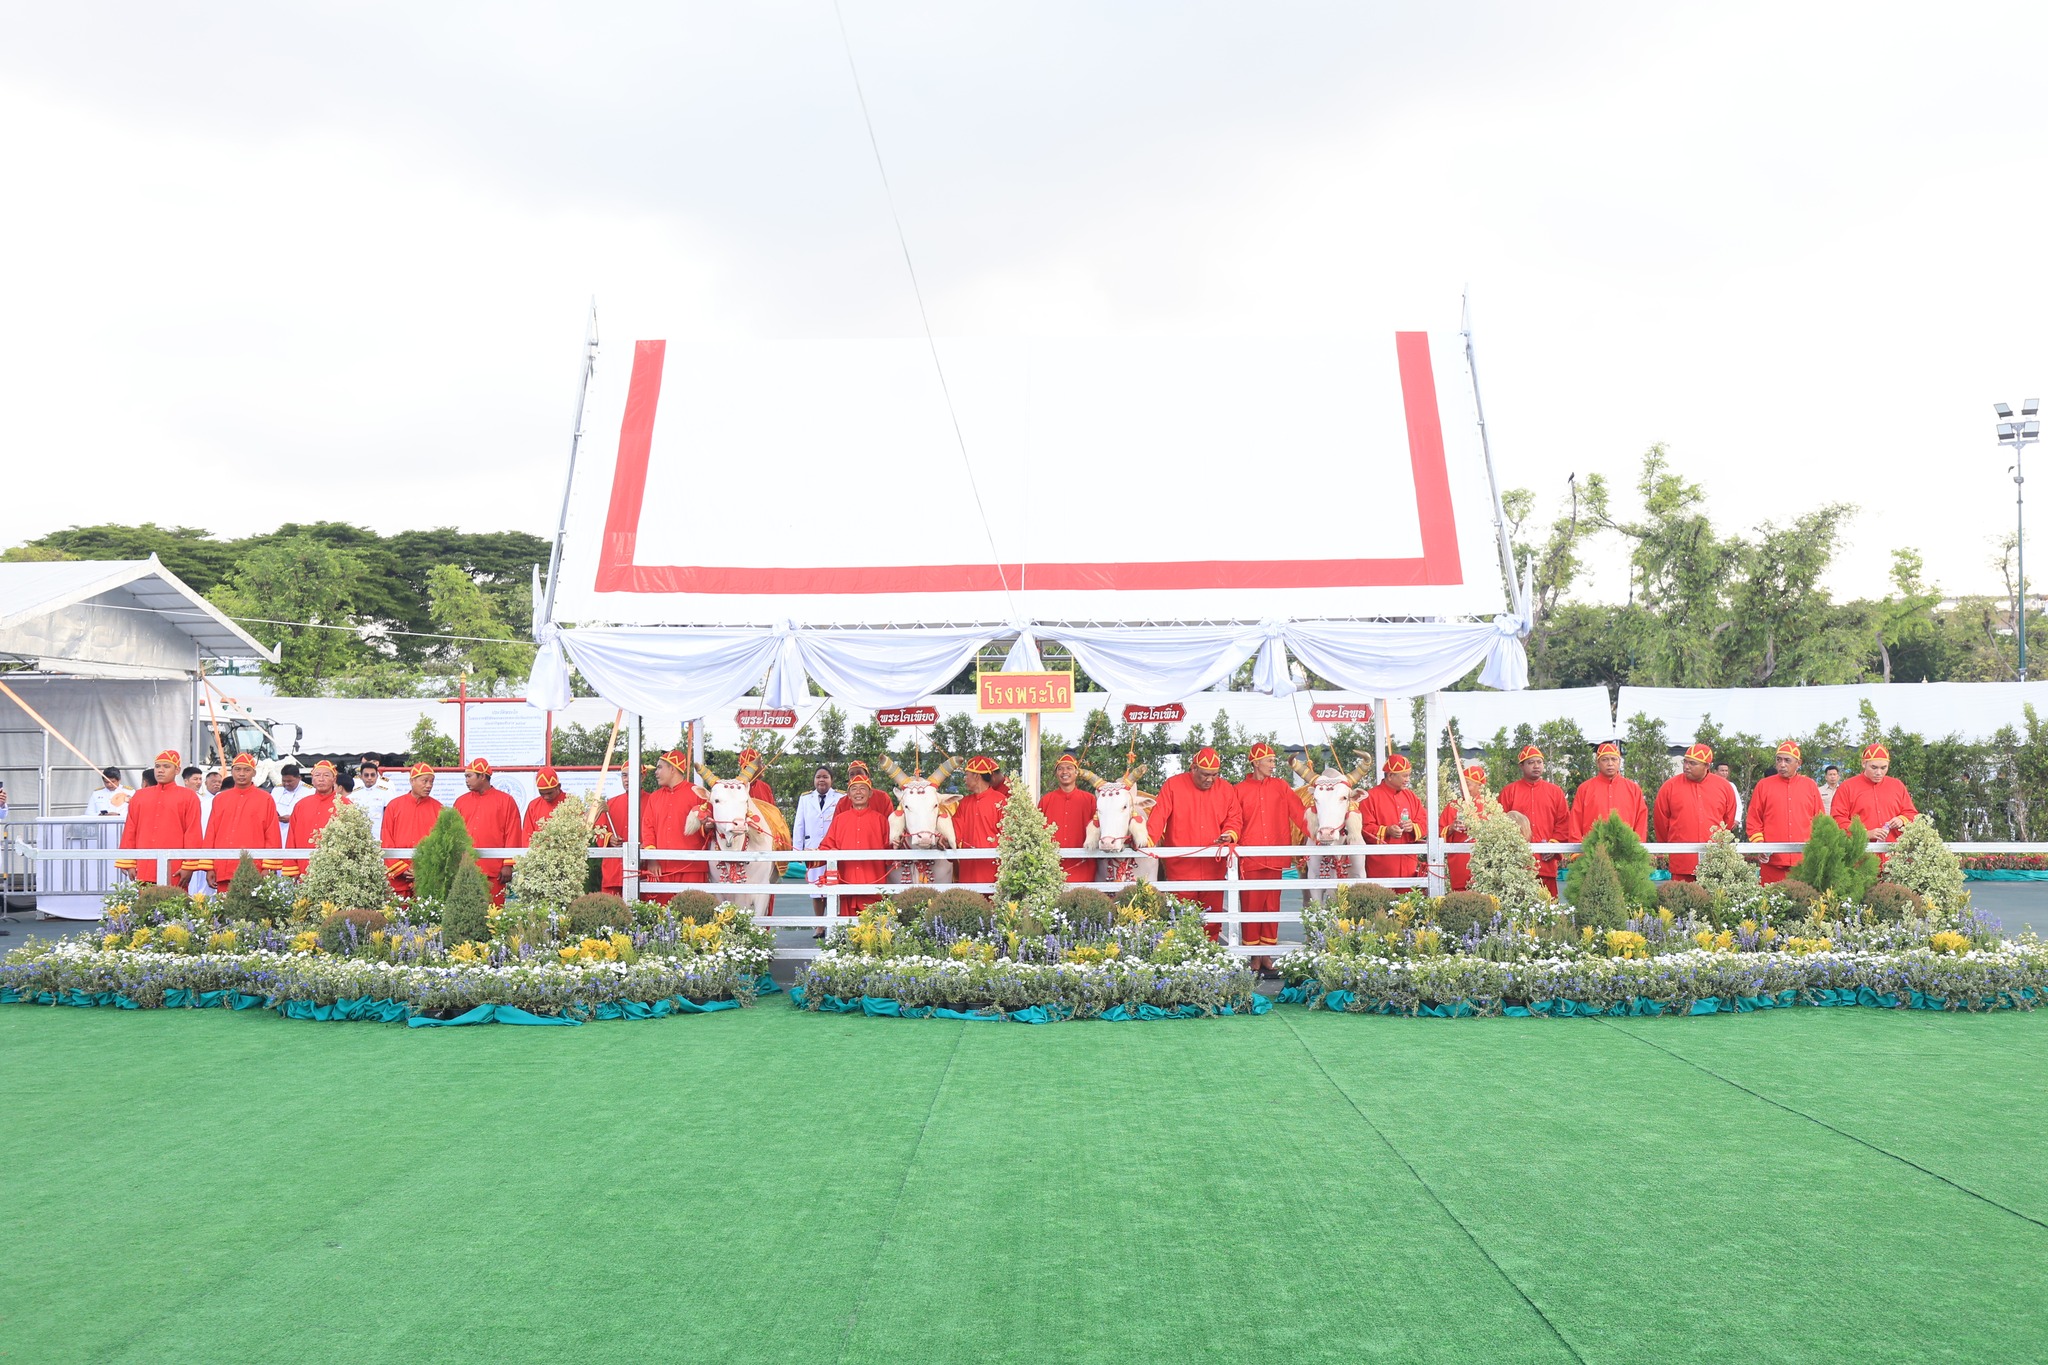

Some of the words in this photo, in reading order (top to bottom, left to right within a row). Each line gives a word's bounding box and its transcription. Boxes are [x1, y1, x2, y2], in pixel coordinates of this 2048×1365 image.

[984, 680, 1067, 704] โรงพระโค
[740, 712, 792, 725] พระโคพอ
[880, 708, 935, 723] พระโคเพียง
[1129, 705, 1179, 720] พระโคเพิ่ม
[1316, 705, 1366, 722] พระโคพูล
